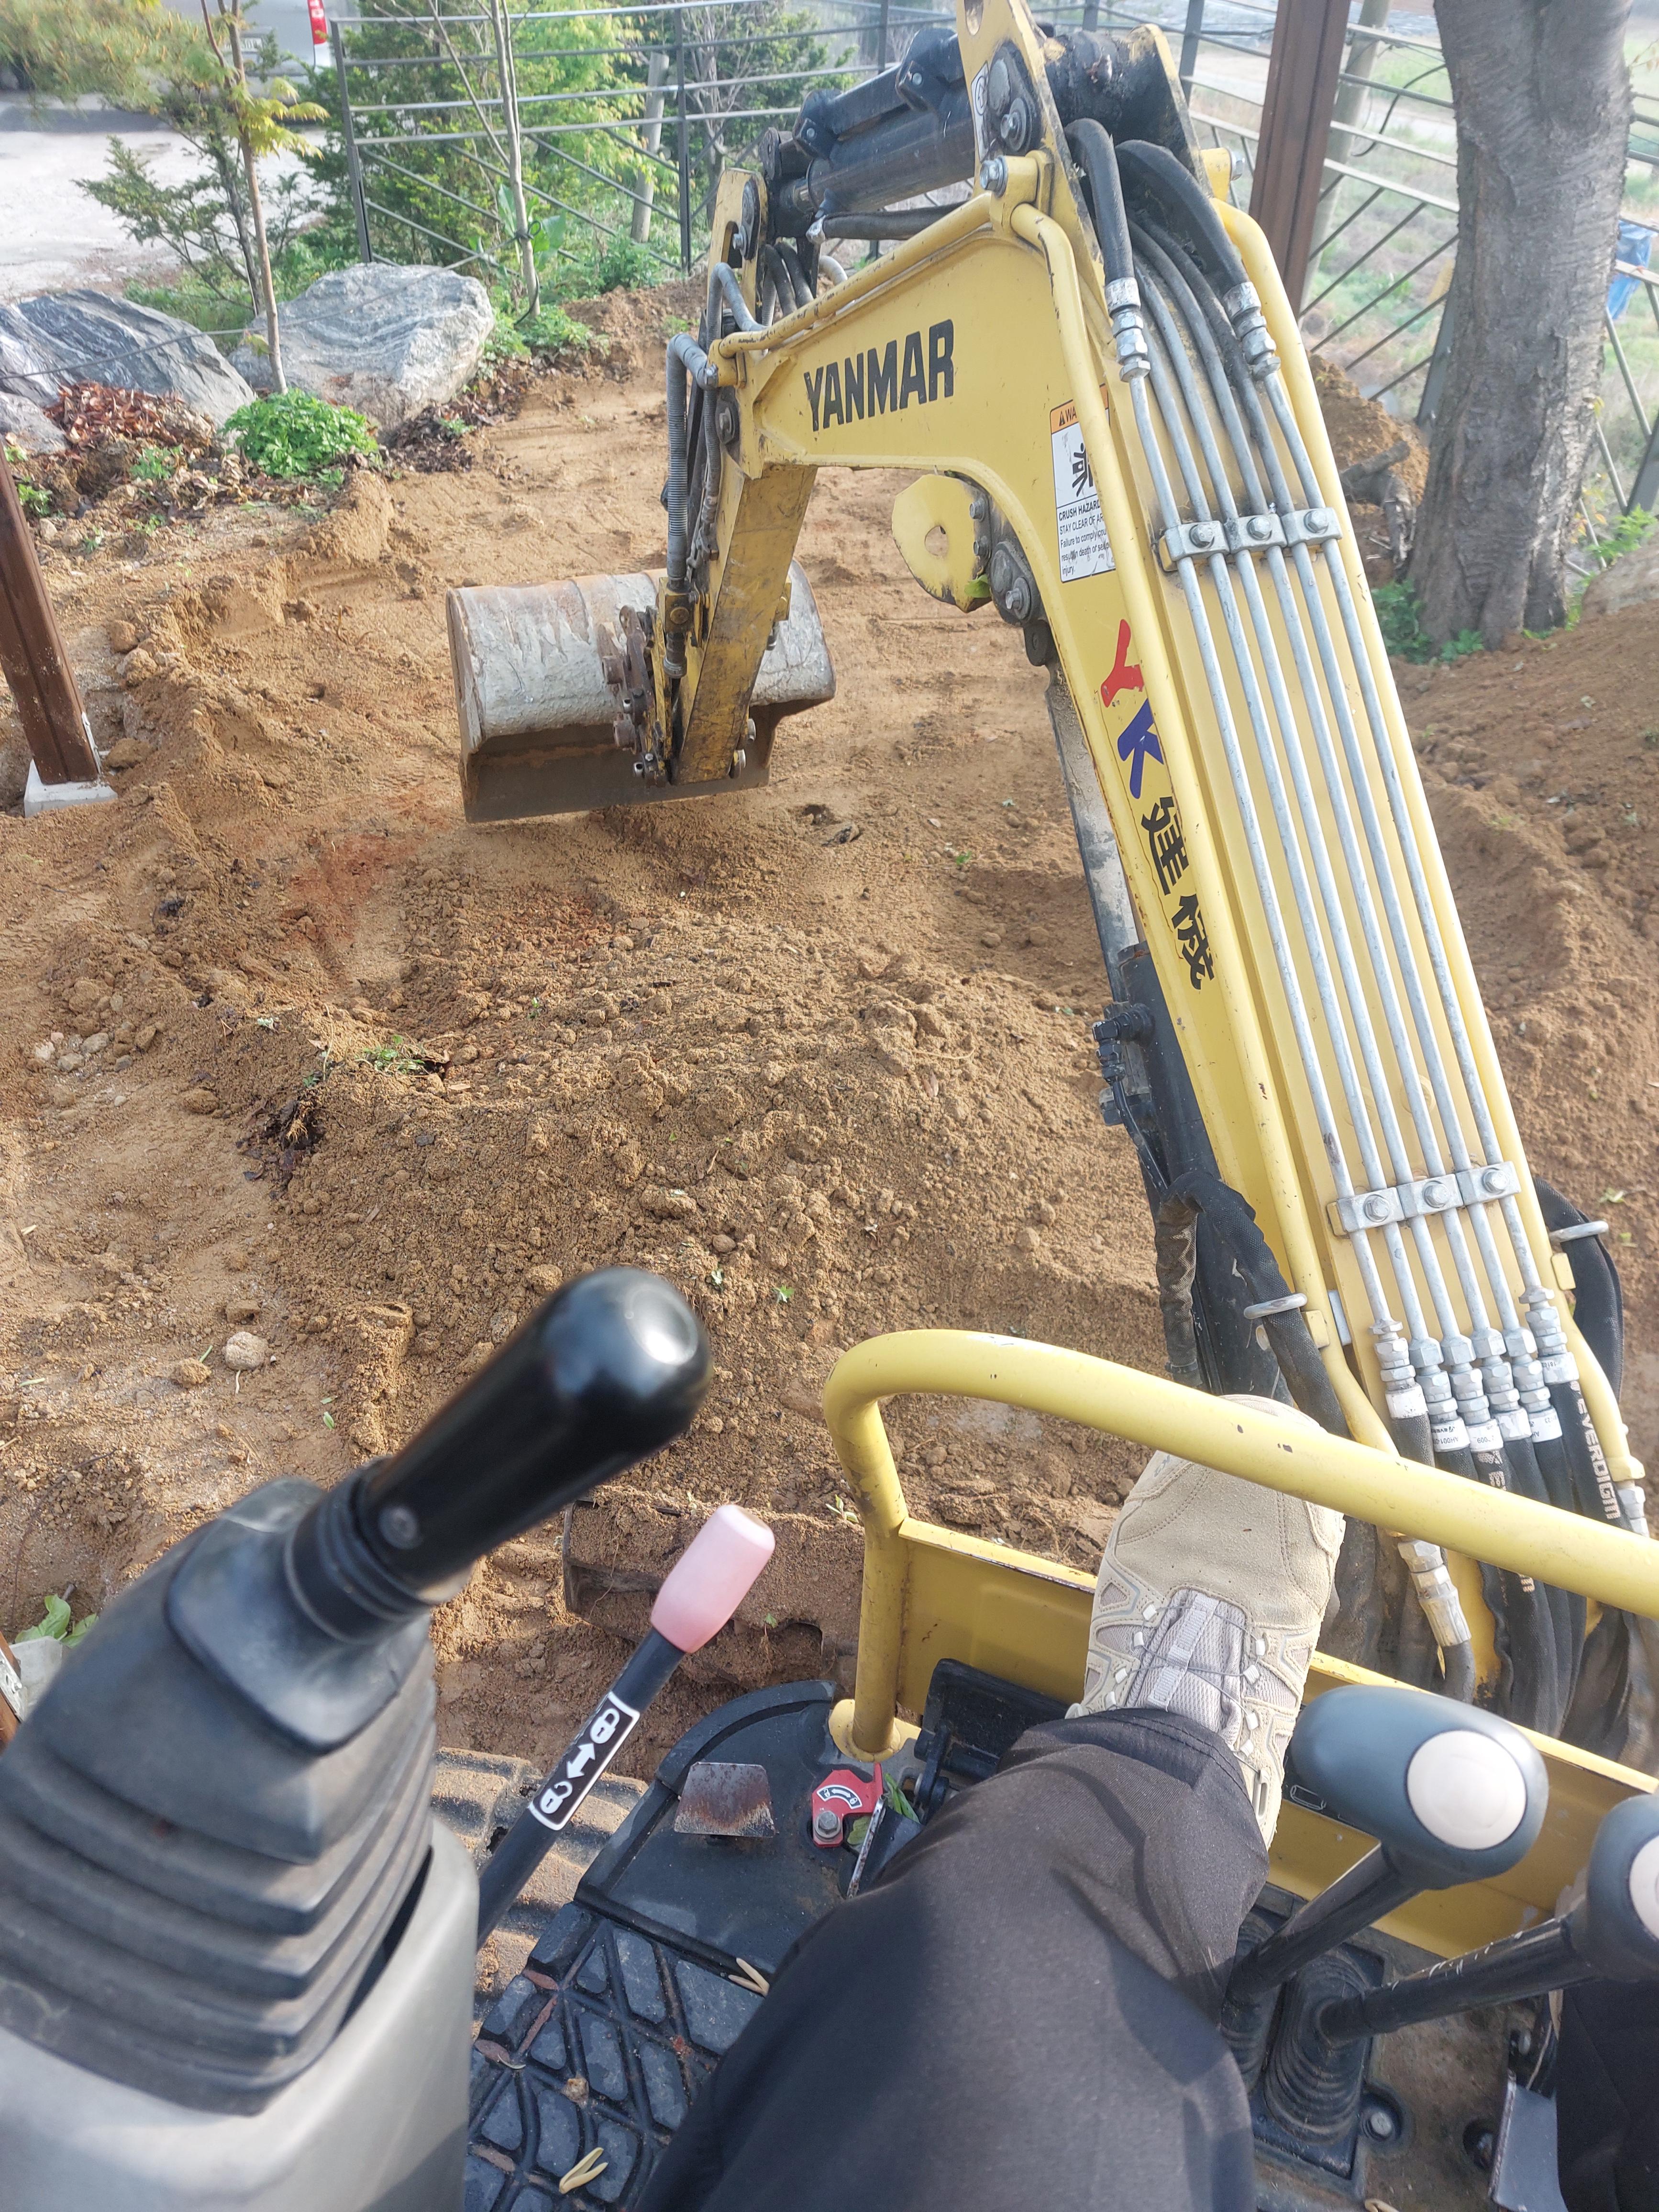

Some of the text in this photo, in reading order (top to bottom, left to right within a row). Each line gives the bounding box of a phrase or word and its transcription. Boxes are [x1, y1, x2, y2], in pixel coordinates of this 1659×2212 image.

[804, 319, 954, 432] YANMAR
[1059, 508, 1077, 521] CRUSH
[1060, 523, 1072, 535] STAY
[1073, 518, 1088, 531] CLEAR
[1089, 515, 1095, 525] OF
[1061, 528, 1106, 549] Failure to comply cou
[1079, 545, 1091, 556] death
[1092, 544, 1097, 553] or
[1577, 1398, 1621, 1520] EVERDIGM
